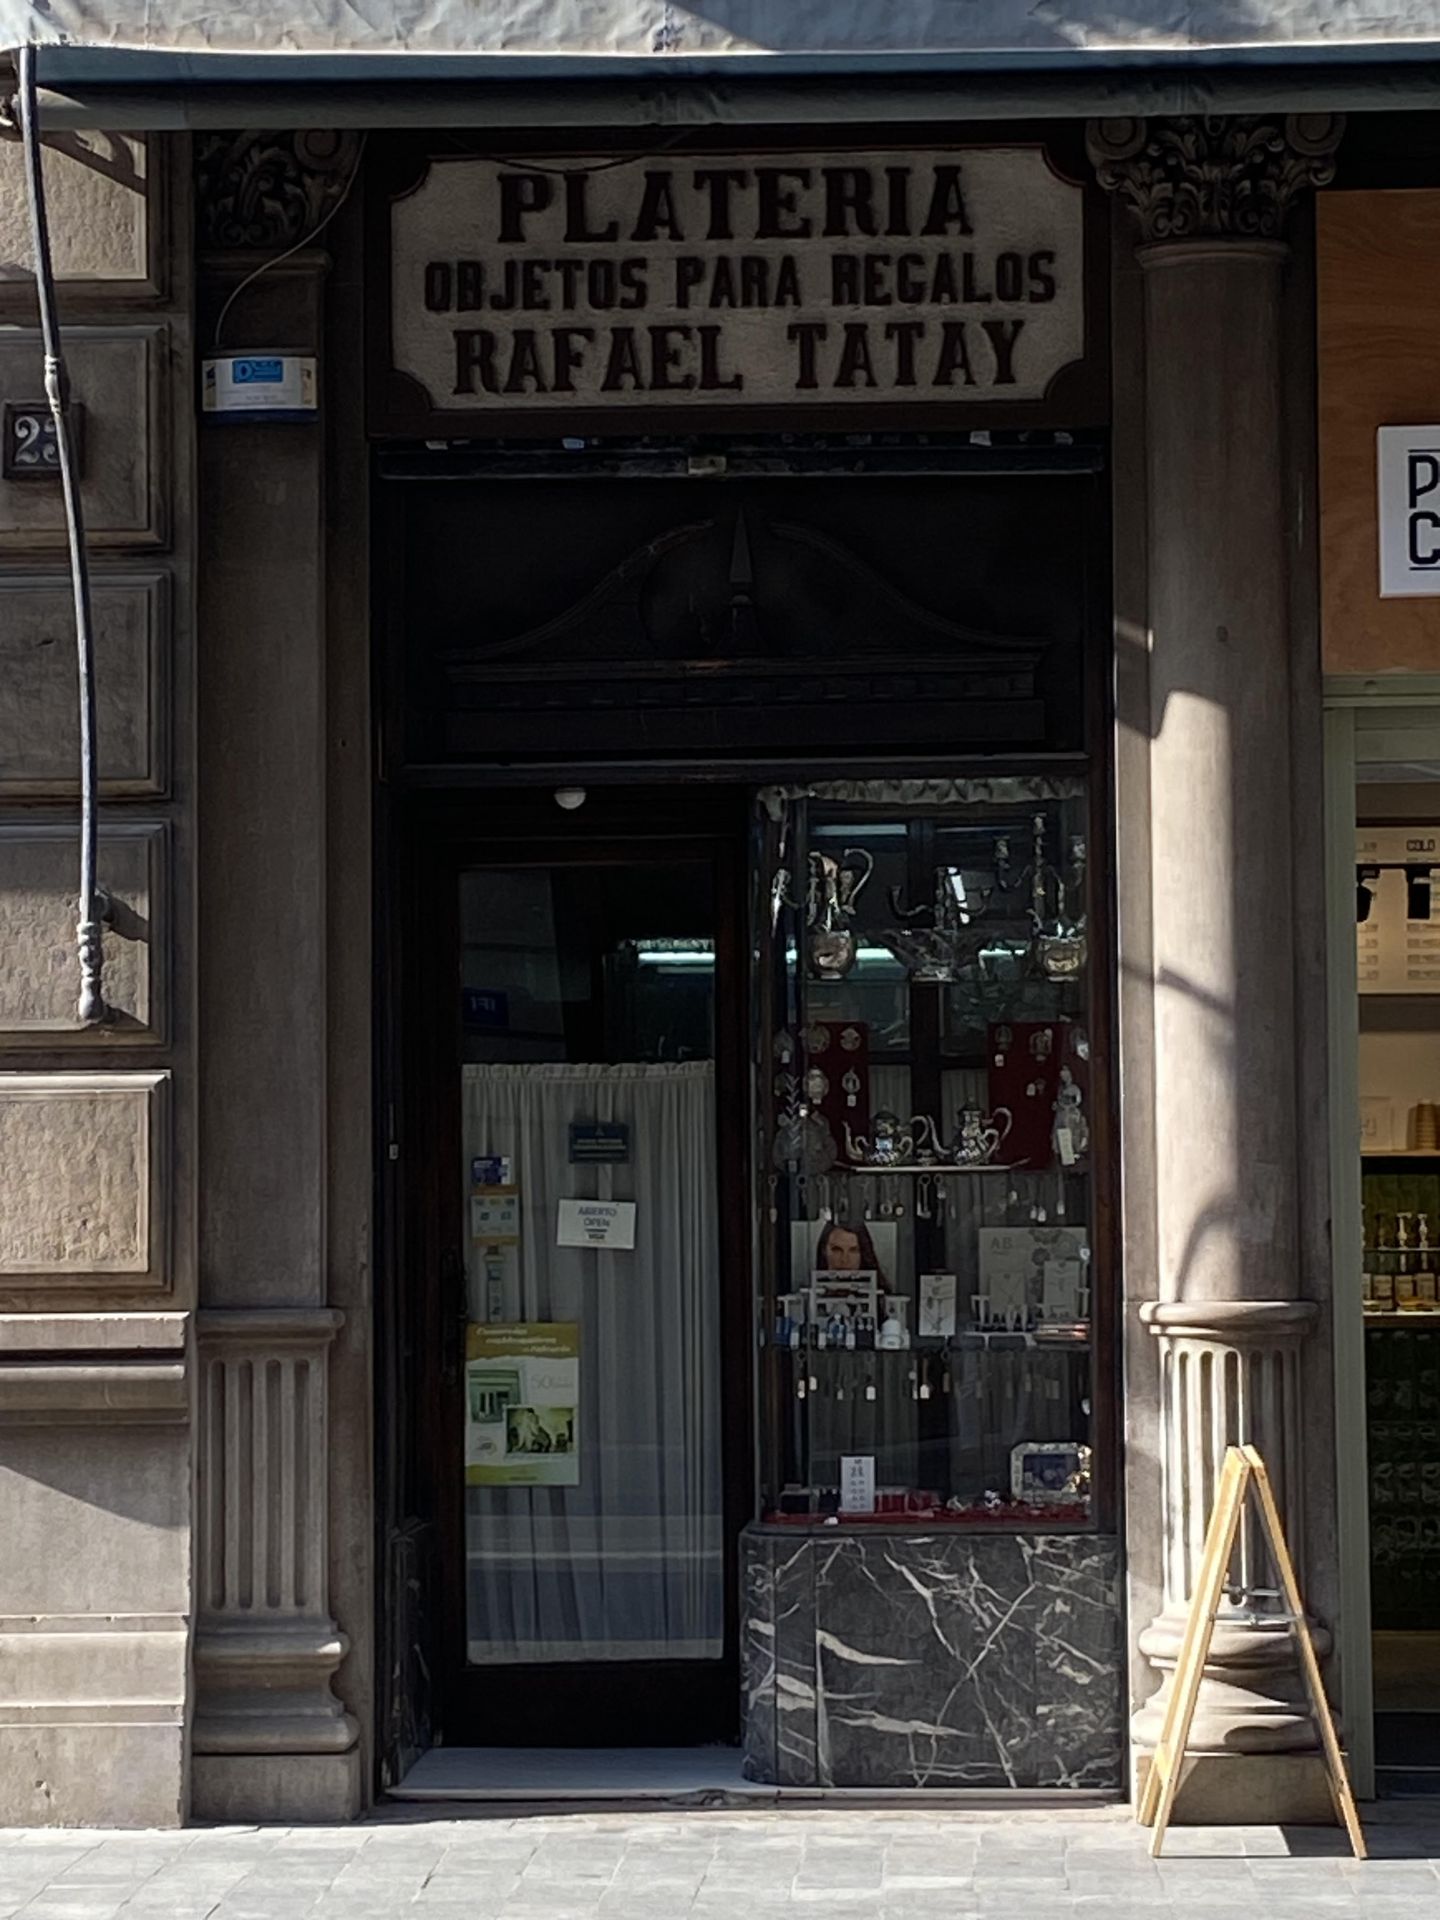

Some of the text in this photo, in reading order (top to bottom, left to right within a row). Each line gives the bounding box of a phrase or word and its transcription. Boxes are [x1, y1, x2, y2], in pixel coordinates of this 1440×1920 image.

[497, 166, 973, 243] PLATERIA
[424, 250, 1057, 312] OBJETOS PARA REGALOS
[453, 319, 1026, 395] RAFAEL TATAY
[583, 1217, 610, 1227] OPEN
